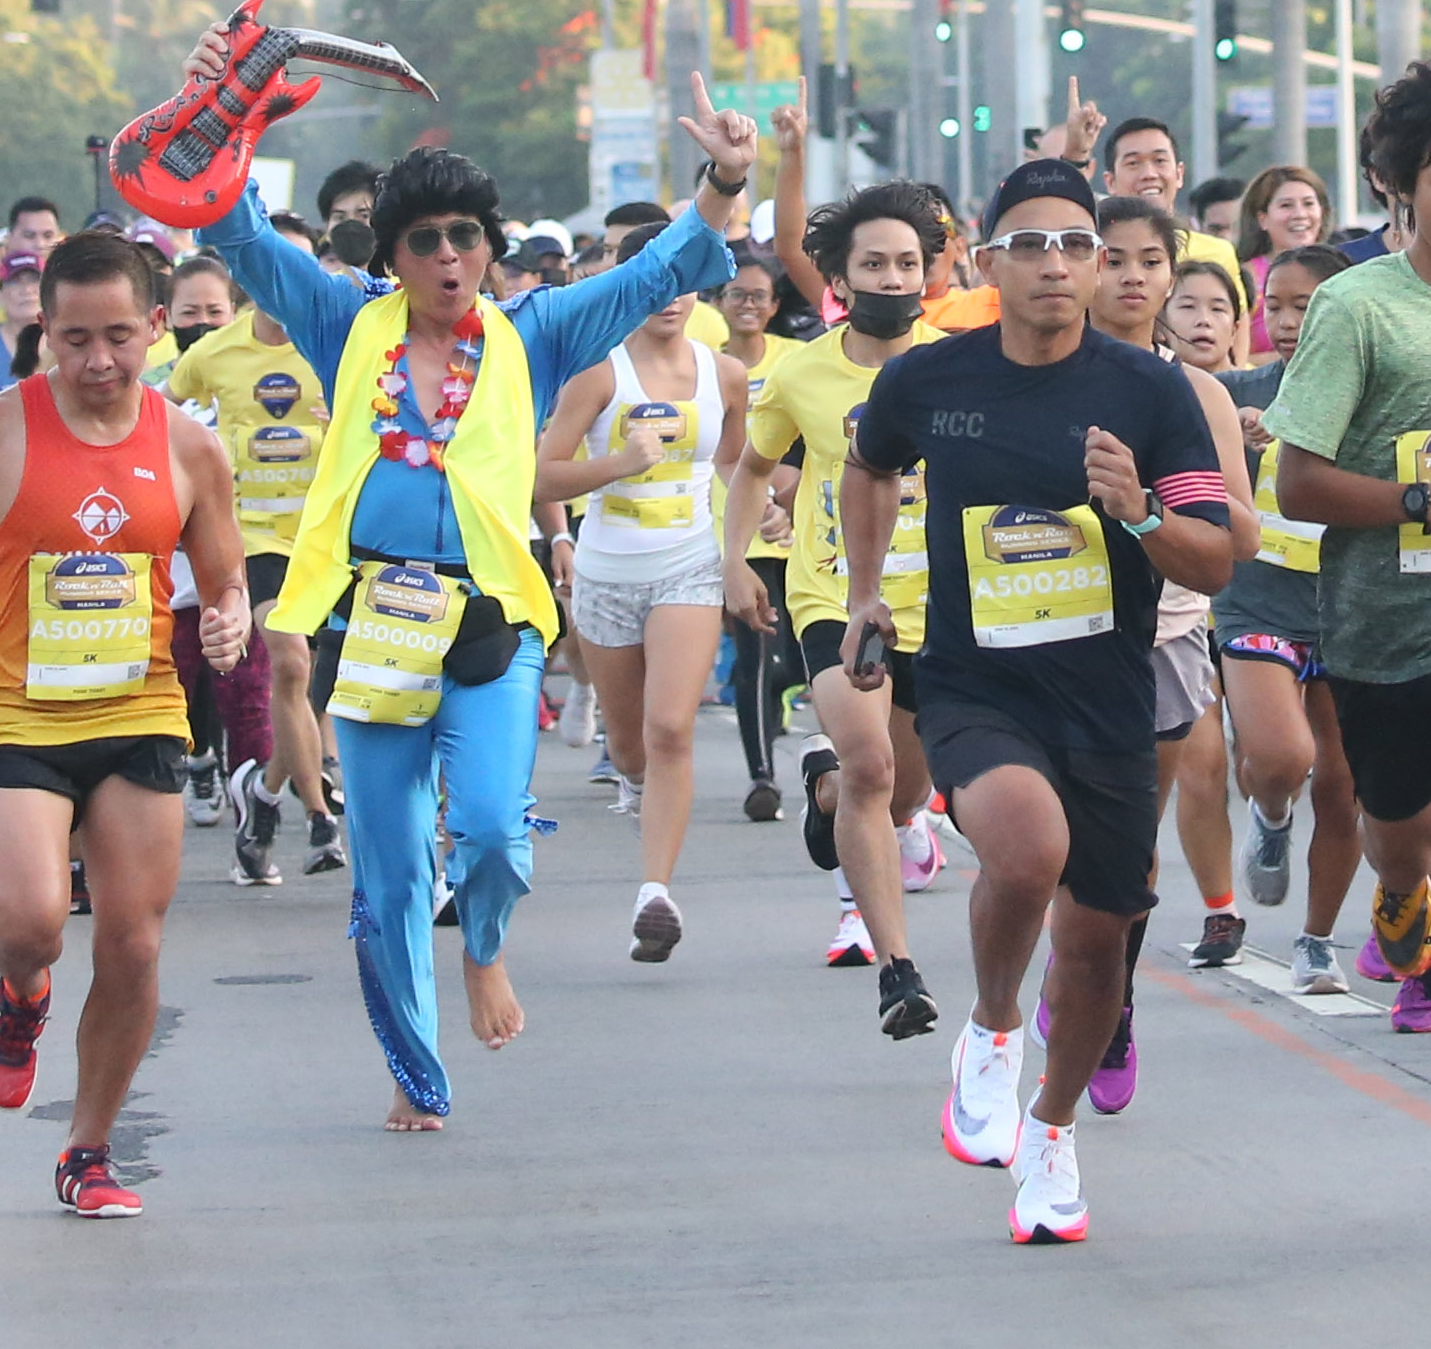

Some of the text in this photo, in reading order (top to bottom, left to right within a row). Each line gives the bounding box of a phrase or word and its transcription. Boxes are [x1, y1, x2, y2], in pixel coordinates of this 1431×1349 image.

[931, 409, 985, 438] RCC
[974, 565, 1108, 600] A500282
[30, 617, 149, 640] A500770
[83, 654, 98, 663] 5K
[384, 657, 400, 668] 5K
